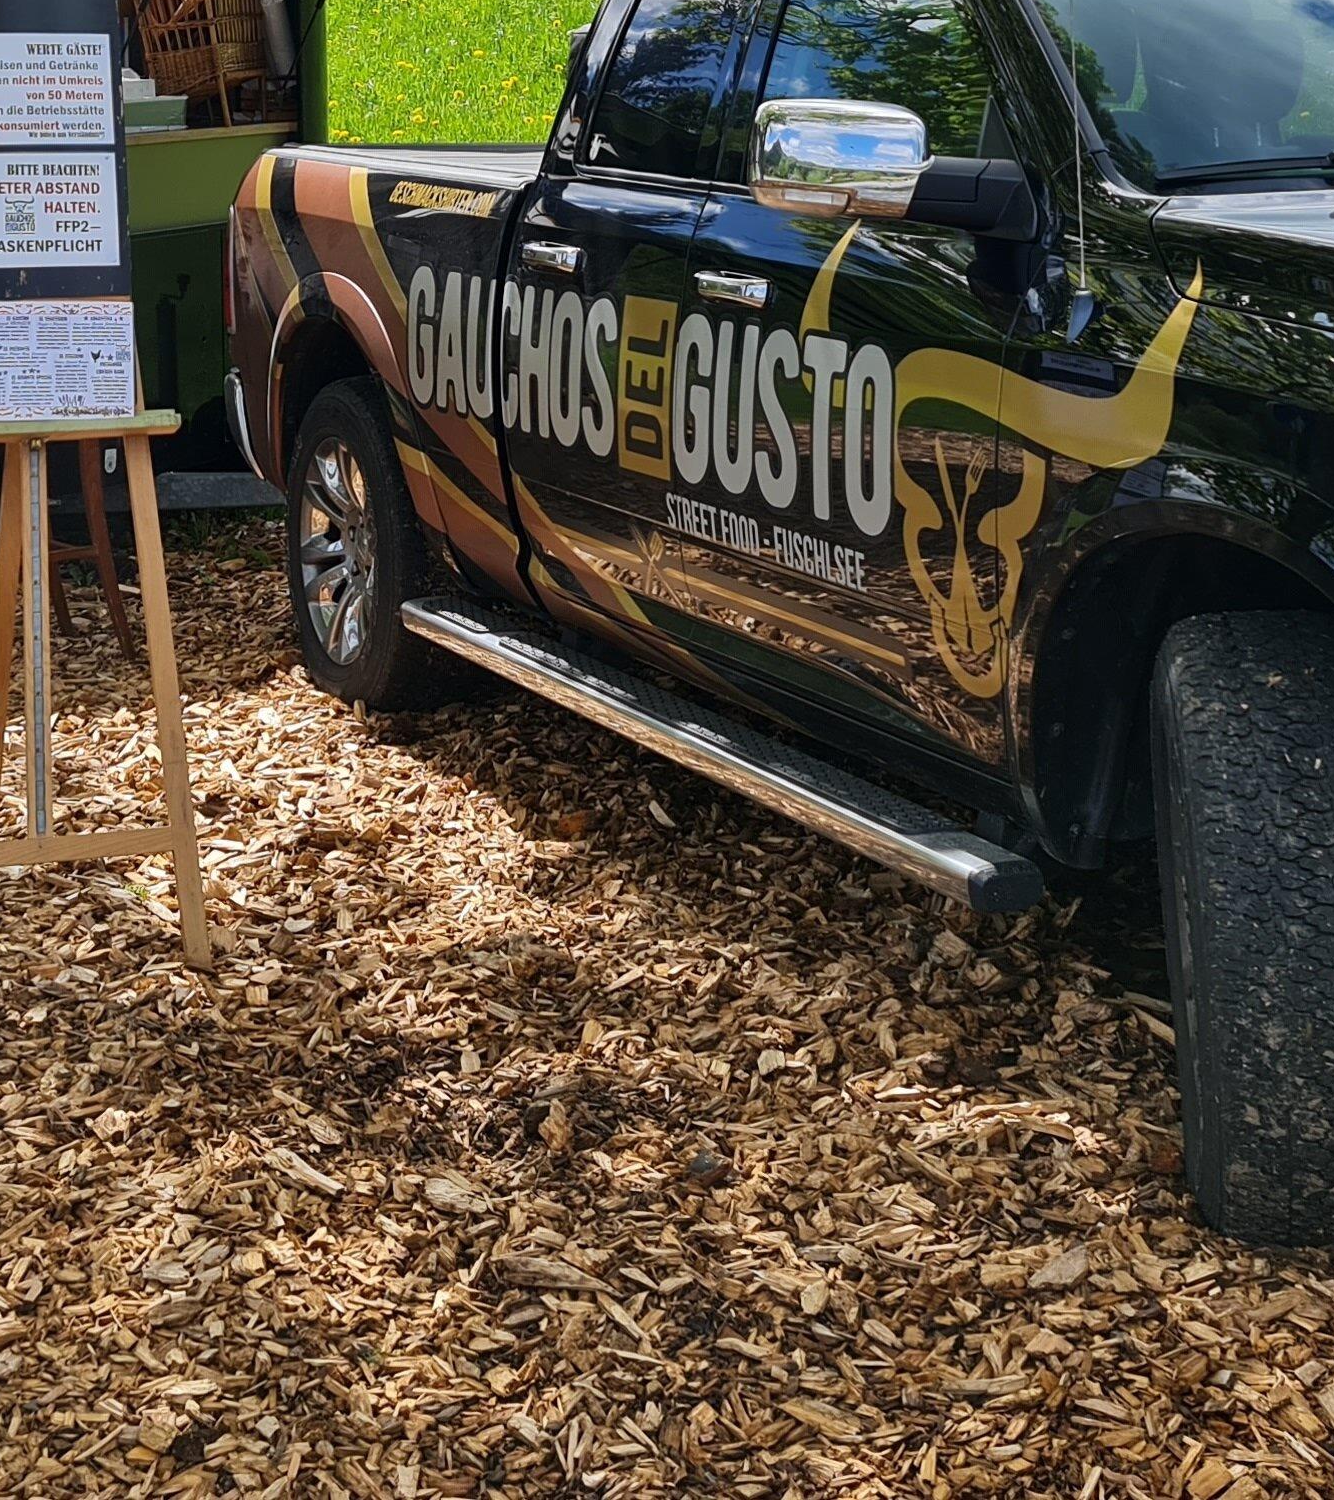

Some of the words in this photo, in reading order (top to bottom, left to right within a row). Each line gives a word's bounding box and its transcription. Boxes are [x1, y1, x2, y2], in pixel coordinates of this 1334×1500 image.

[26, 43, 63, 56] WERTE
[66, 42, 102, 56] GÄSTE!
[25, 60, 46, 70] und
[48, 60, 99, 70] Getränke
[12, 75, 40, 85] nicht
[42, 75, 56, 85] im
[59, 75, 104, 85] Umkreis
[25, 91, 45, 100] von
[48, 90, 62, 100] 50
[65, 90, 104, 100] Metern
[6, 105, 24, 116] die
[26, 105, 105, 116] Betriebsstätte
[62, 121, 105, 131] werden.
[7, 164, 39, 176] BITTE
[42, 164, 100, 176] BEACHTEN!
[35, 182, 100, 194] ABSTAND
[44, 201, 101, 214] HALTEN.
[407, 265, 619, 458] GAUCHOS
[625, 319, 666, 460] DEL
[673, 312, 893, 537] GUSTO
[665, 492, 718, 542] STREET
[720, 509, 761, 557] FOOD
